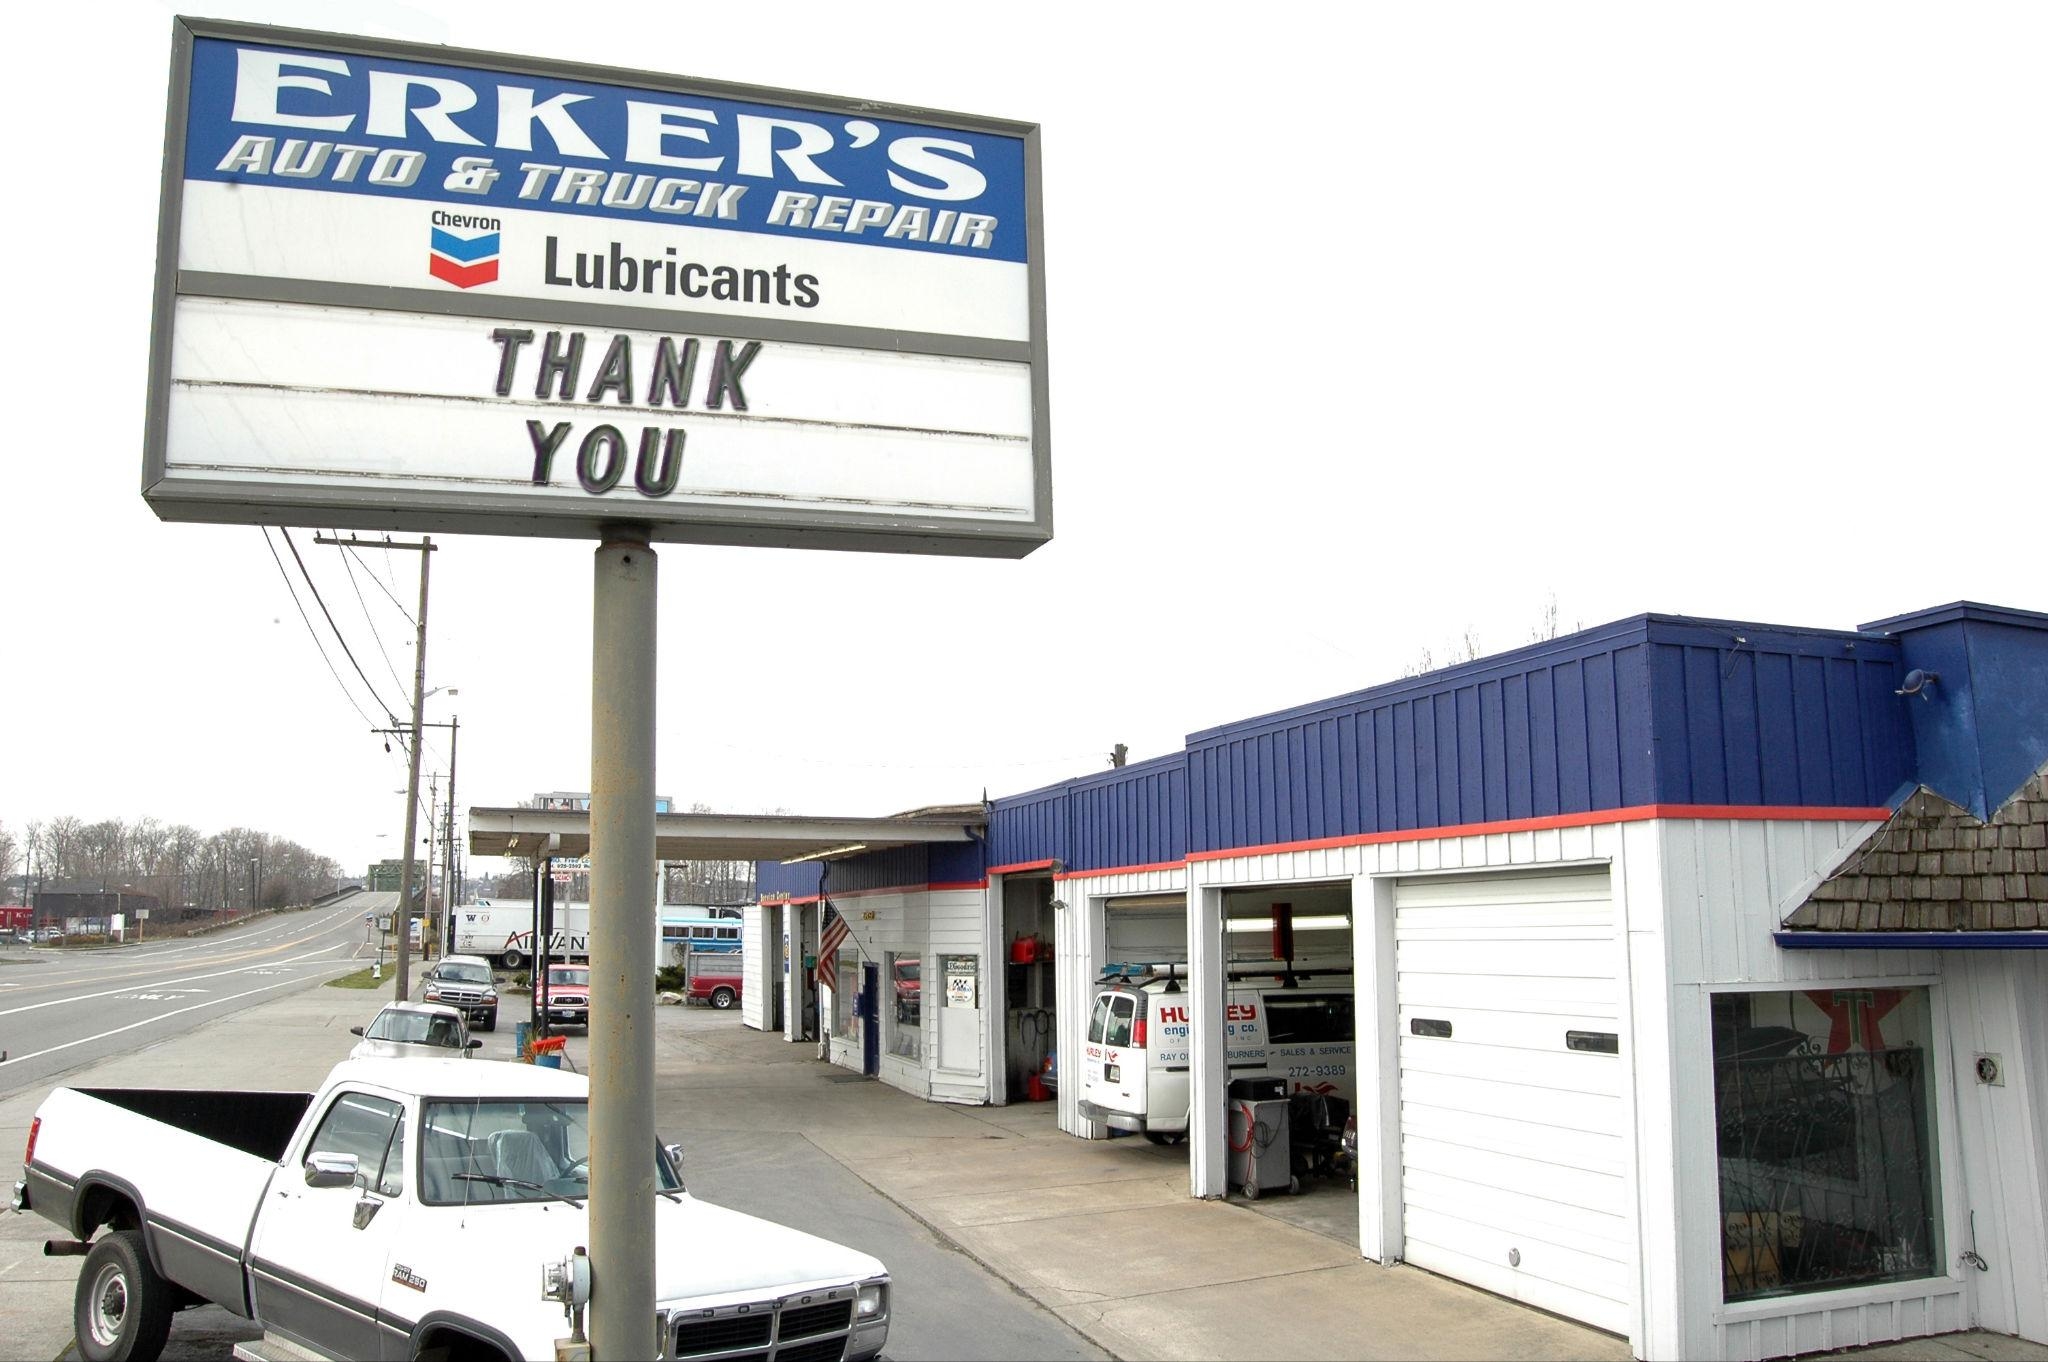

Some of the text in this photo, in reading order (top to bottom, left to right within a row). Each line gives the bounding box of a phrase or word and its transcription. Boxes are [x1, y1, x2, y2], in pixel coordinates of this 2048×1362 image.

[230, 48, 988, 201] ERKER'S
[216, 134, 998, 250] AUTO & TRUCK REPAIR
[431, 210, 501, 231] Chevron
[544, 234, 821, 308] Lubricants
[491, 327, 763, 412] THANK
[525, 420, 687, 497] YOU
[1160, 1052, 1177, 1061] RAY
[1227, 1049, 1266, 1059] BURNERS
[1280, 1048, 1306, 1057] SALES
[1319, 1046, 1352, 1055] SERVICE
[1241, 1024, 1258, 1033] co.
[1288, 1064, 1346, 1077] 272-9389
